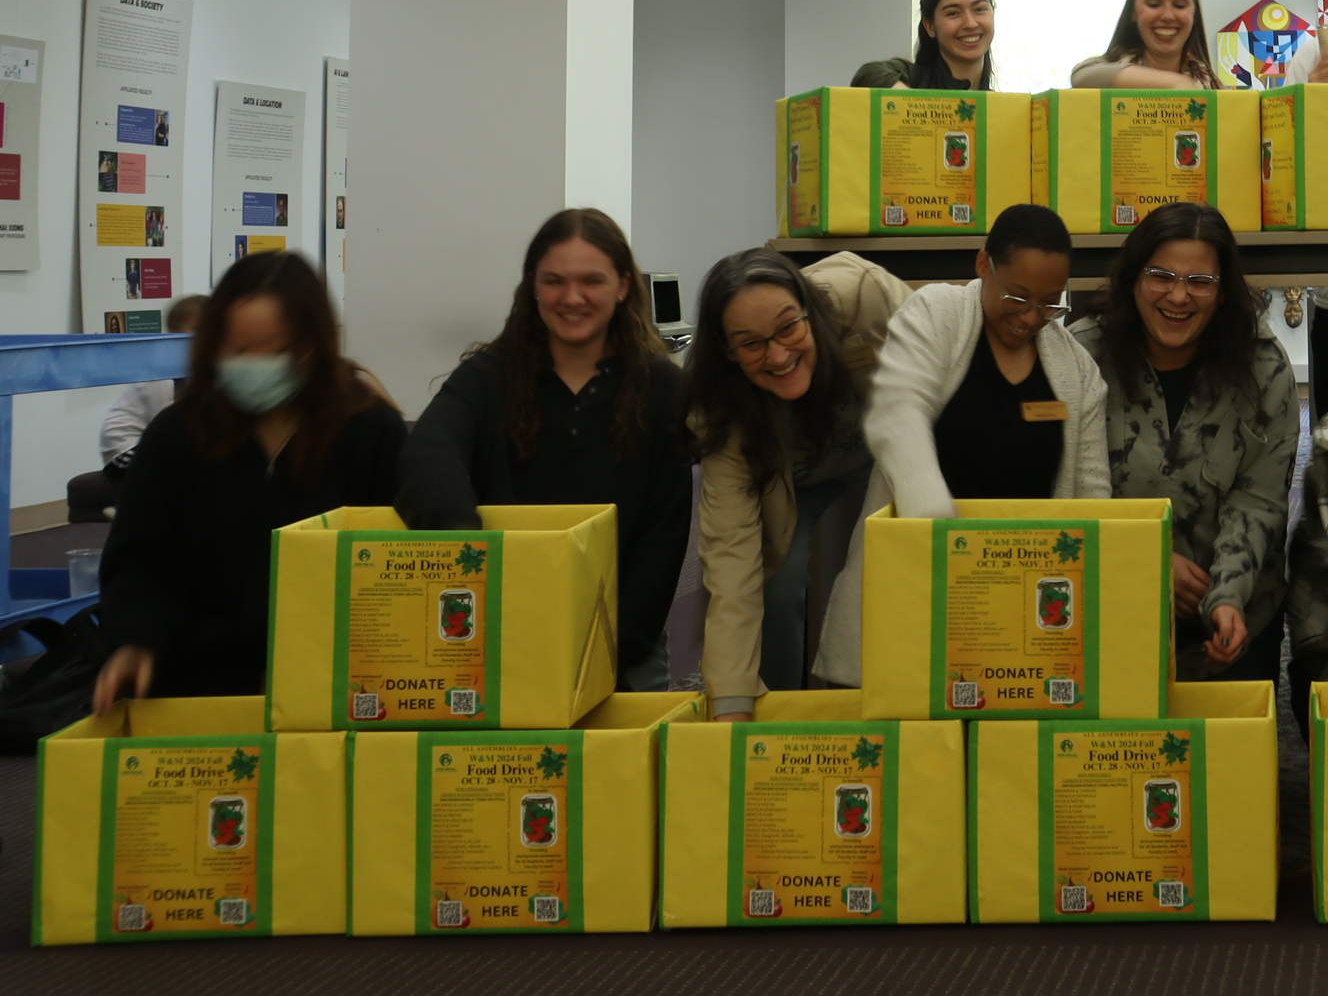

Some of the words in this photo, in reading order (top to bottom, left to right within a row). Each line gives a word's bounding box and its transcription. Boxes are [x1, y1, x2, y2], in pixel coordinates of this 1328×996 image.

[140, 0, 164, 12] SOCIETY
[260, 99, 283, 109] LOCATION
[906, 110, 927, 118] Food
[930, 110, 954, 119] Drive
[1136, 109, 1158, 118] Food
[1160, 110, 1184, 118] Drive
[908, 196, 949, 205] DONATE
[1138, 195, 1180, 204] DONATE
[916, 210, 943, 219] HERE
[982, 547, 1013, 559] Food
[1017, 547, 1050, 559] Drive
[386, 560, 416, 571] Food
[420, 559, 454, 571] Drive
[984, 667, 1044, 680] DONATE
[386, 678, 446, 691] DONATE
[997, 687, 1035, 699] HERE
[398, 698, 436, 710] HERE
[781, 753, 812, 765] Food
[816, 753, 850, 766] Drive
[1089, 750, 1119, 762] Food
[1123, 749, 1157, 761] Drive
[155, 767, 186, 779] Food
[190, 766, 225, 778] Drive
[467, 764, 497, 776] Food
[501, 764, 535, 776] Drive
[782, 875, 842, 888] DONATE
[1093, 871, 1153, 883] DONATE
[153, 888, 215, 901] DONATE
[469, 885, 529, 898] DONATE
[1106, 891, 1144, 902] HERE
[794, 896, 832, 907] HERE
[166, 909, 205, 920] HERE
[482, 906, 519, 917] HERE
